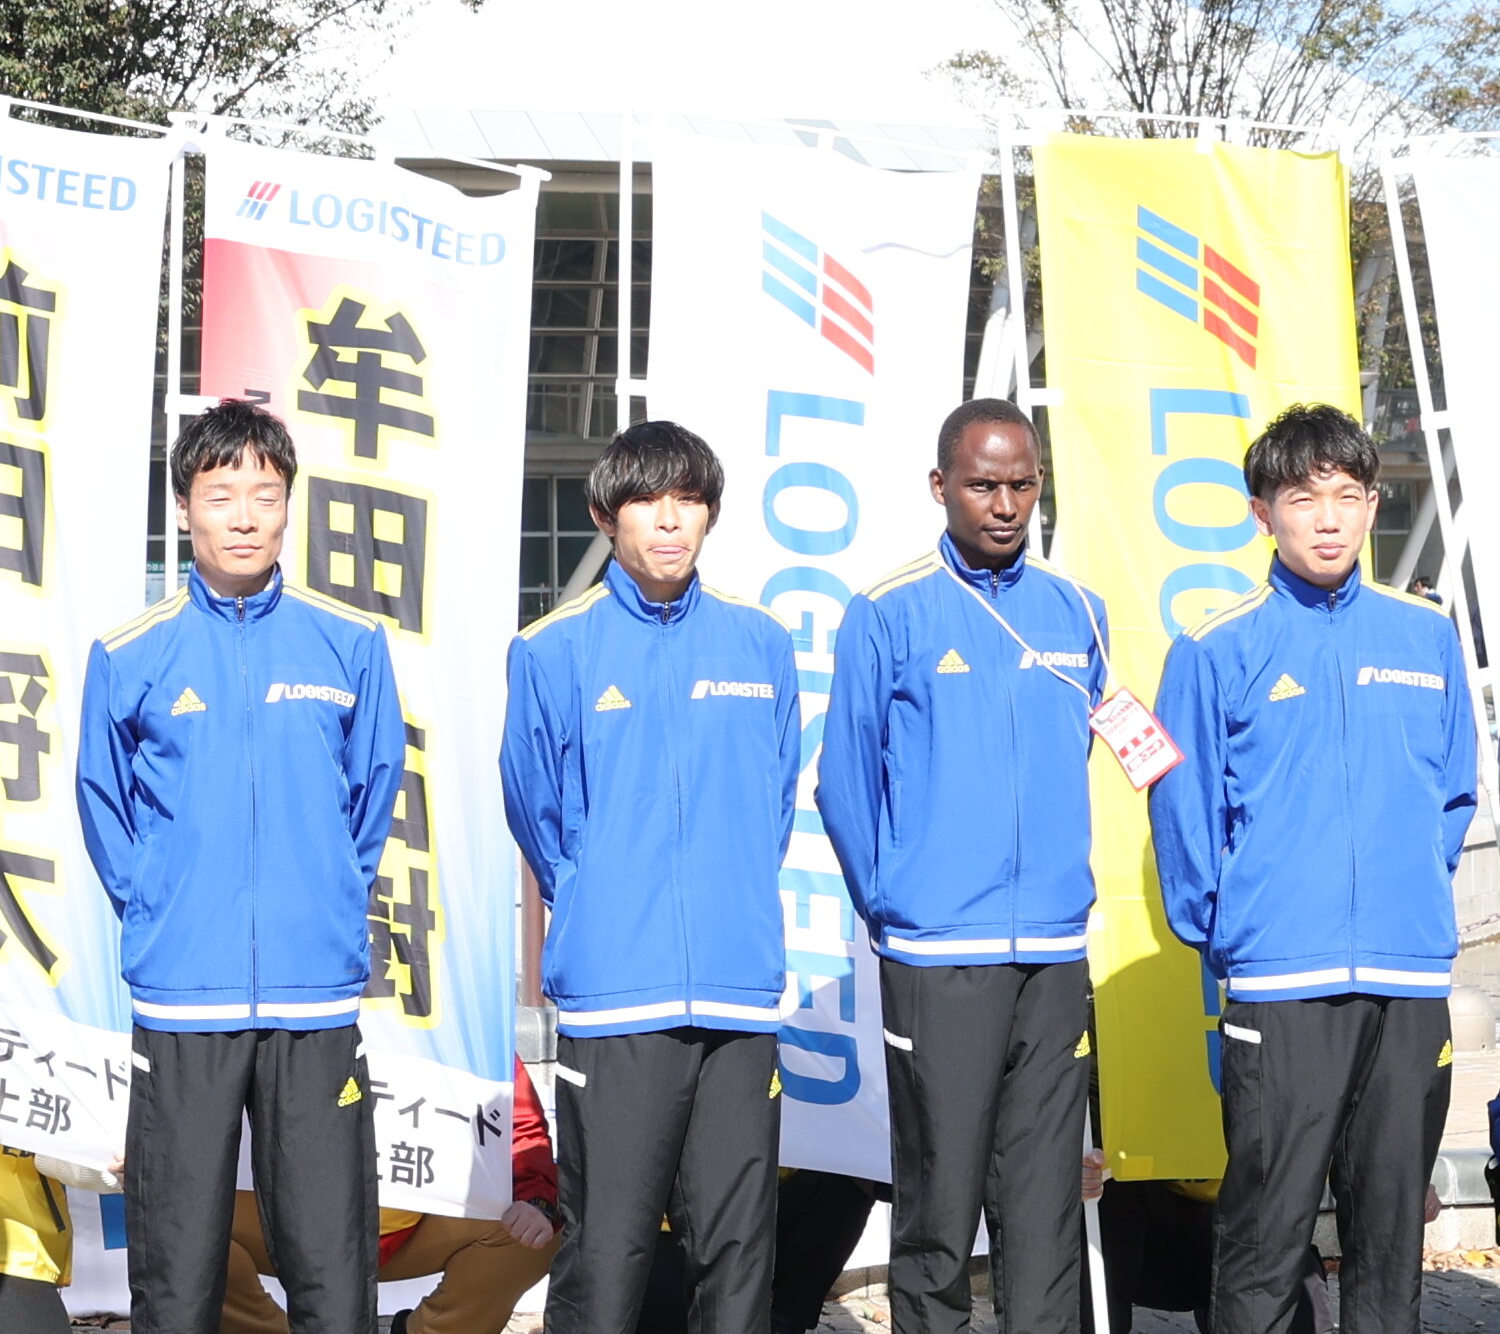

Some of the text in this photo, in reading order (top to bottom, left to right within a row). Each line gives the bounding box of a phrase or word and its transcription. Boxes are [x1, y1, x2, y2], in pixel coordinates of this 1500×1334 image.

[288, 190, 507, 267] LOGISTEED
[297, 297, 435, 635] 牟田
[285, 683, 357, 708] LOGISTEED
